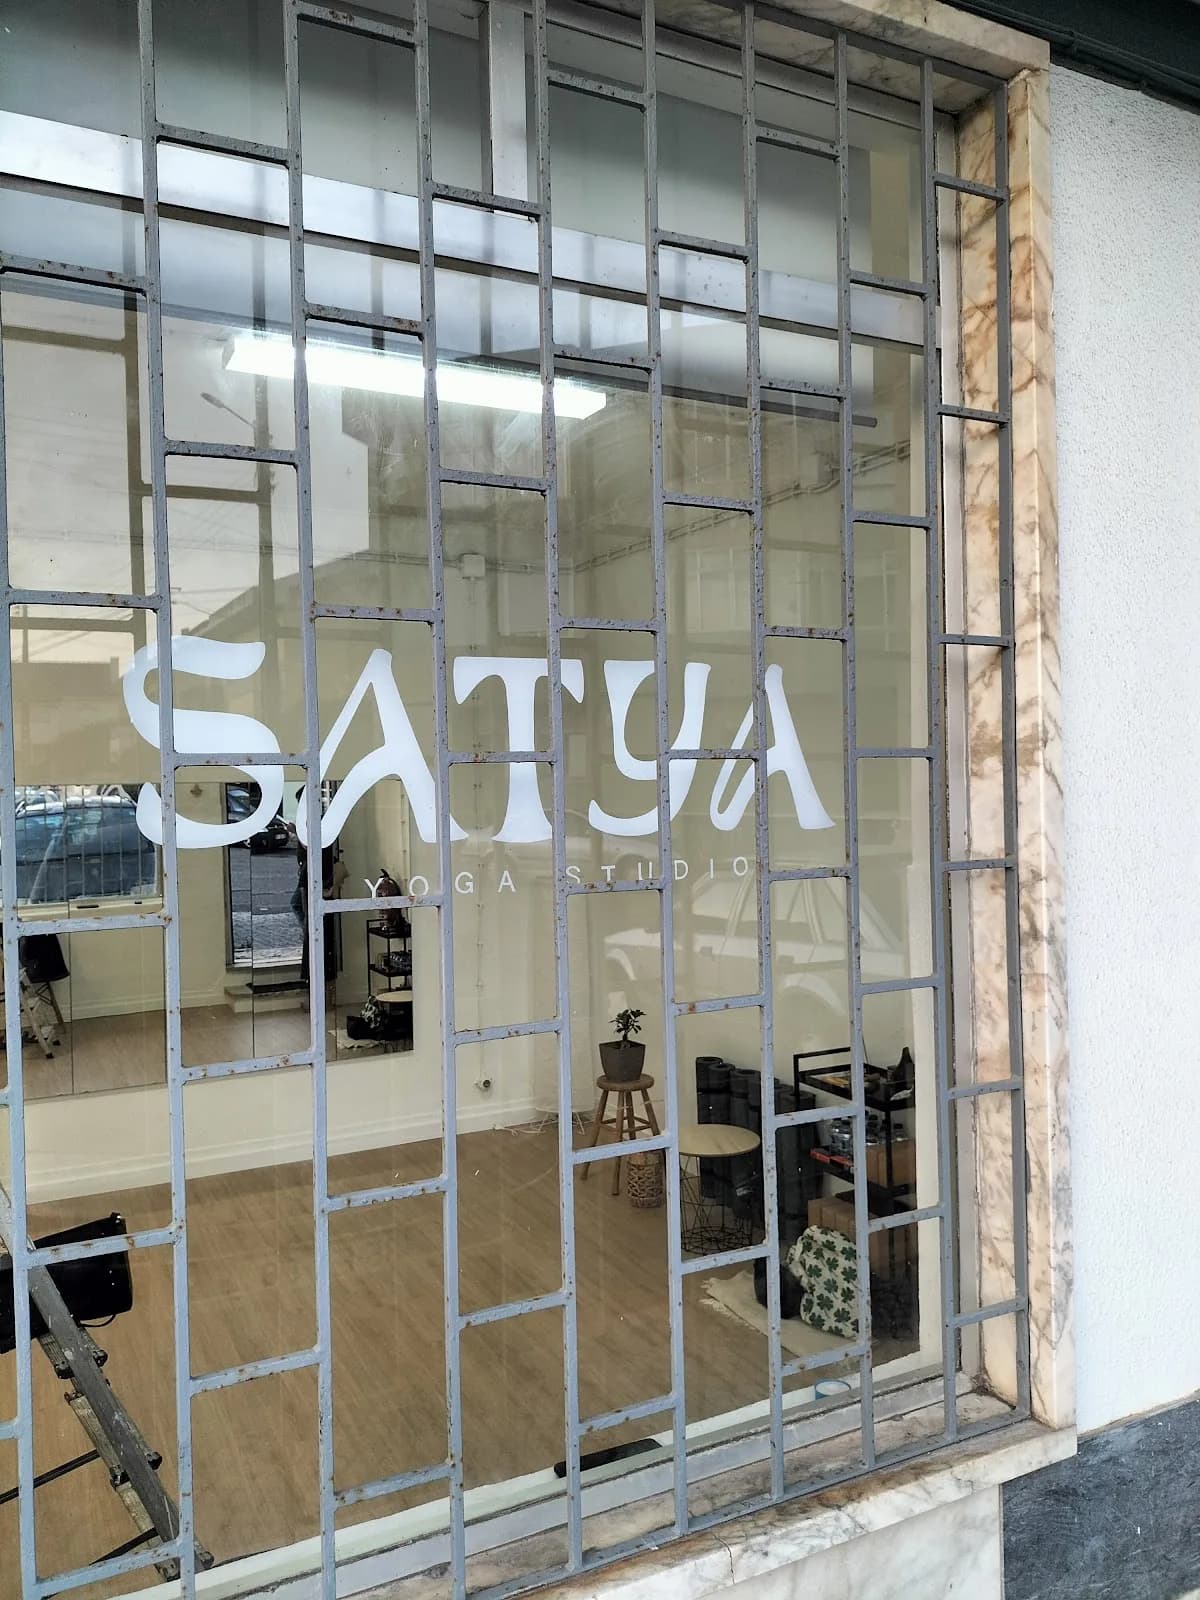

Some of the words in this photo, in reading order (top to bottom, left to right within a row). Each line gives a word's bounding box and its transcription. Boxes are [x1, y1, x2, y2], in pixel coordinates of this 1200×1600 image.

[123, 635, 837, 850] SATYA
[364, 870, 517, 898] YOGA
[565, 857, 749, 884] STUDIO
